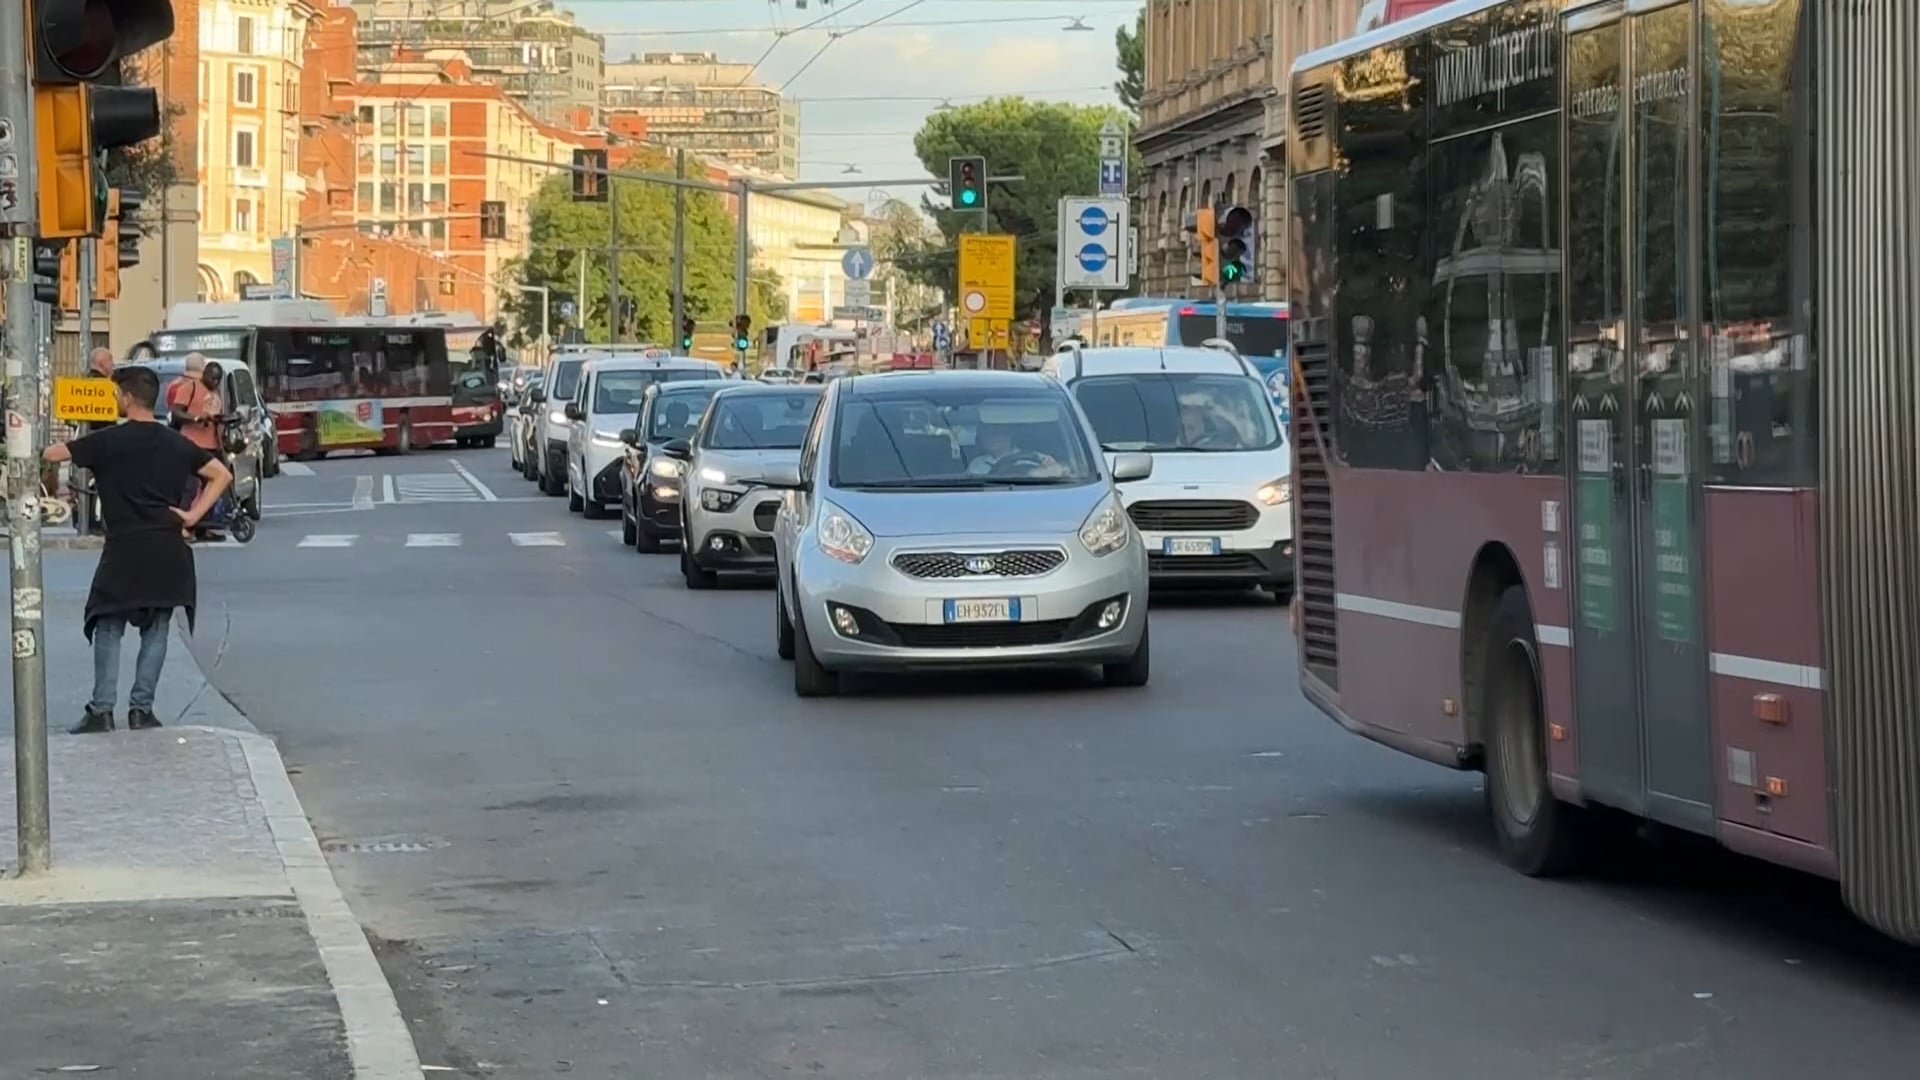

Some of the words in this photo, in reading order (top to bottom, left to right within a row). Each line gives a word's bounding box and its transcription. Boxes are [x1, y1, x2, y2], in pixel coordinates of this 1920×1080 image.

[70, 385, 106, 397] inizio
[60, 404, 114, 415] cantiere
[968, 559, 992, 571] KIA
